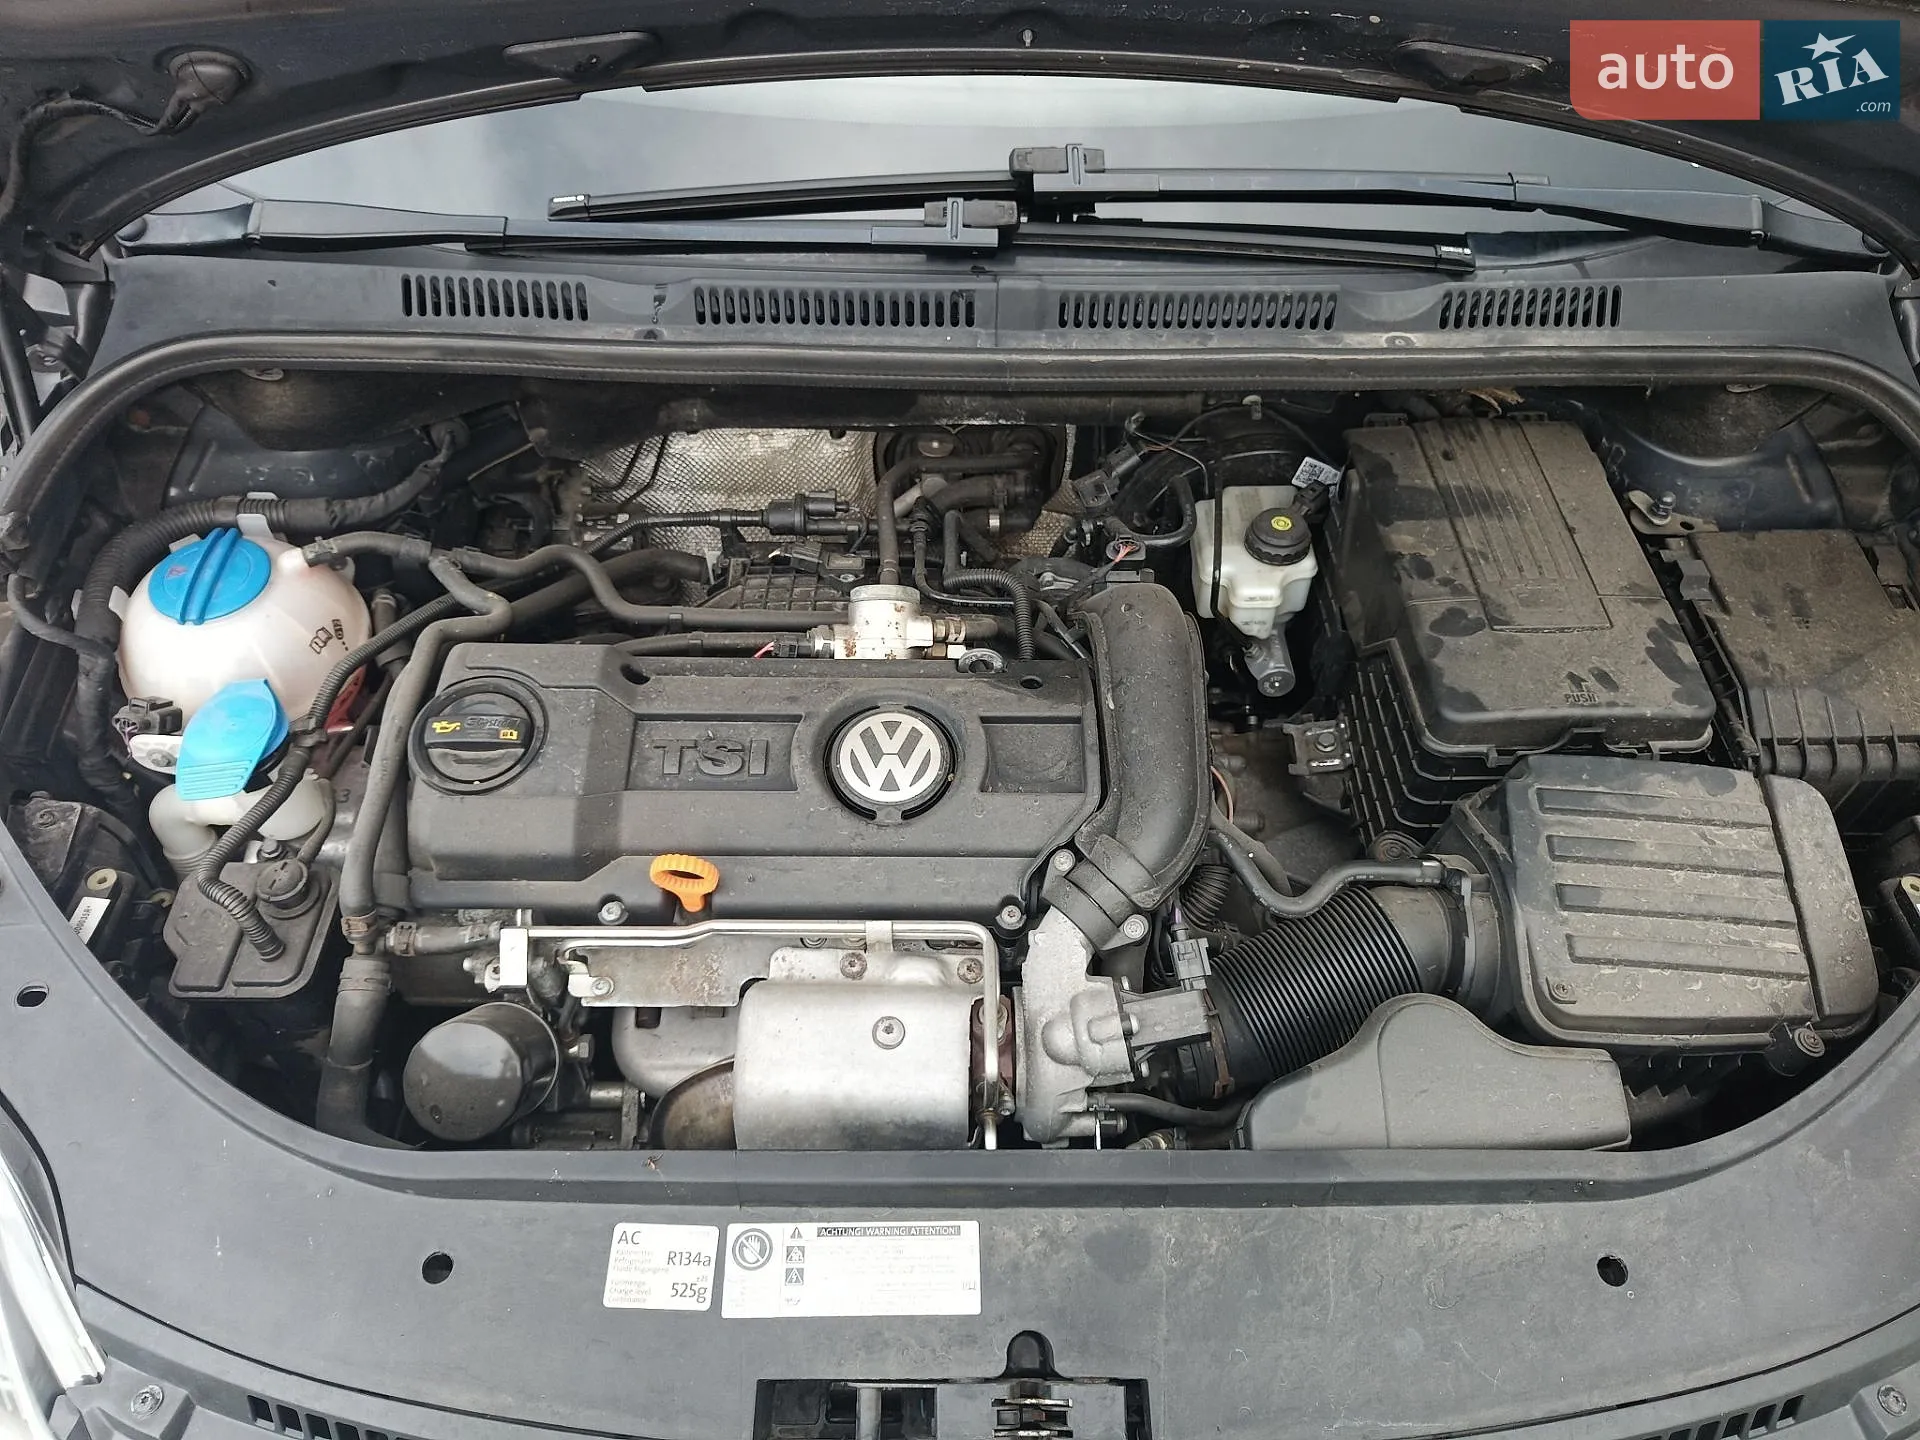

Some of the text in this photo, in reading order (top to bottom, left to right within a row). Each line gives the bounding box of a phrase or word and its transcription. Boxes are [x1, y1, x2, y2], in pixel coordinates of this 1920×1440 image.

[1563, 693, 1599, 703] PUSH
[652, 739, 769, 776] TSI
[617, 1230, 642, 1245] AC
[819, 1226, 960, 1236] ACHTUNG! WARNING! ATTENTION!
[666, 1250, 711, 1267] R134a
[670, 1282, 708, 1304] 525g
